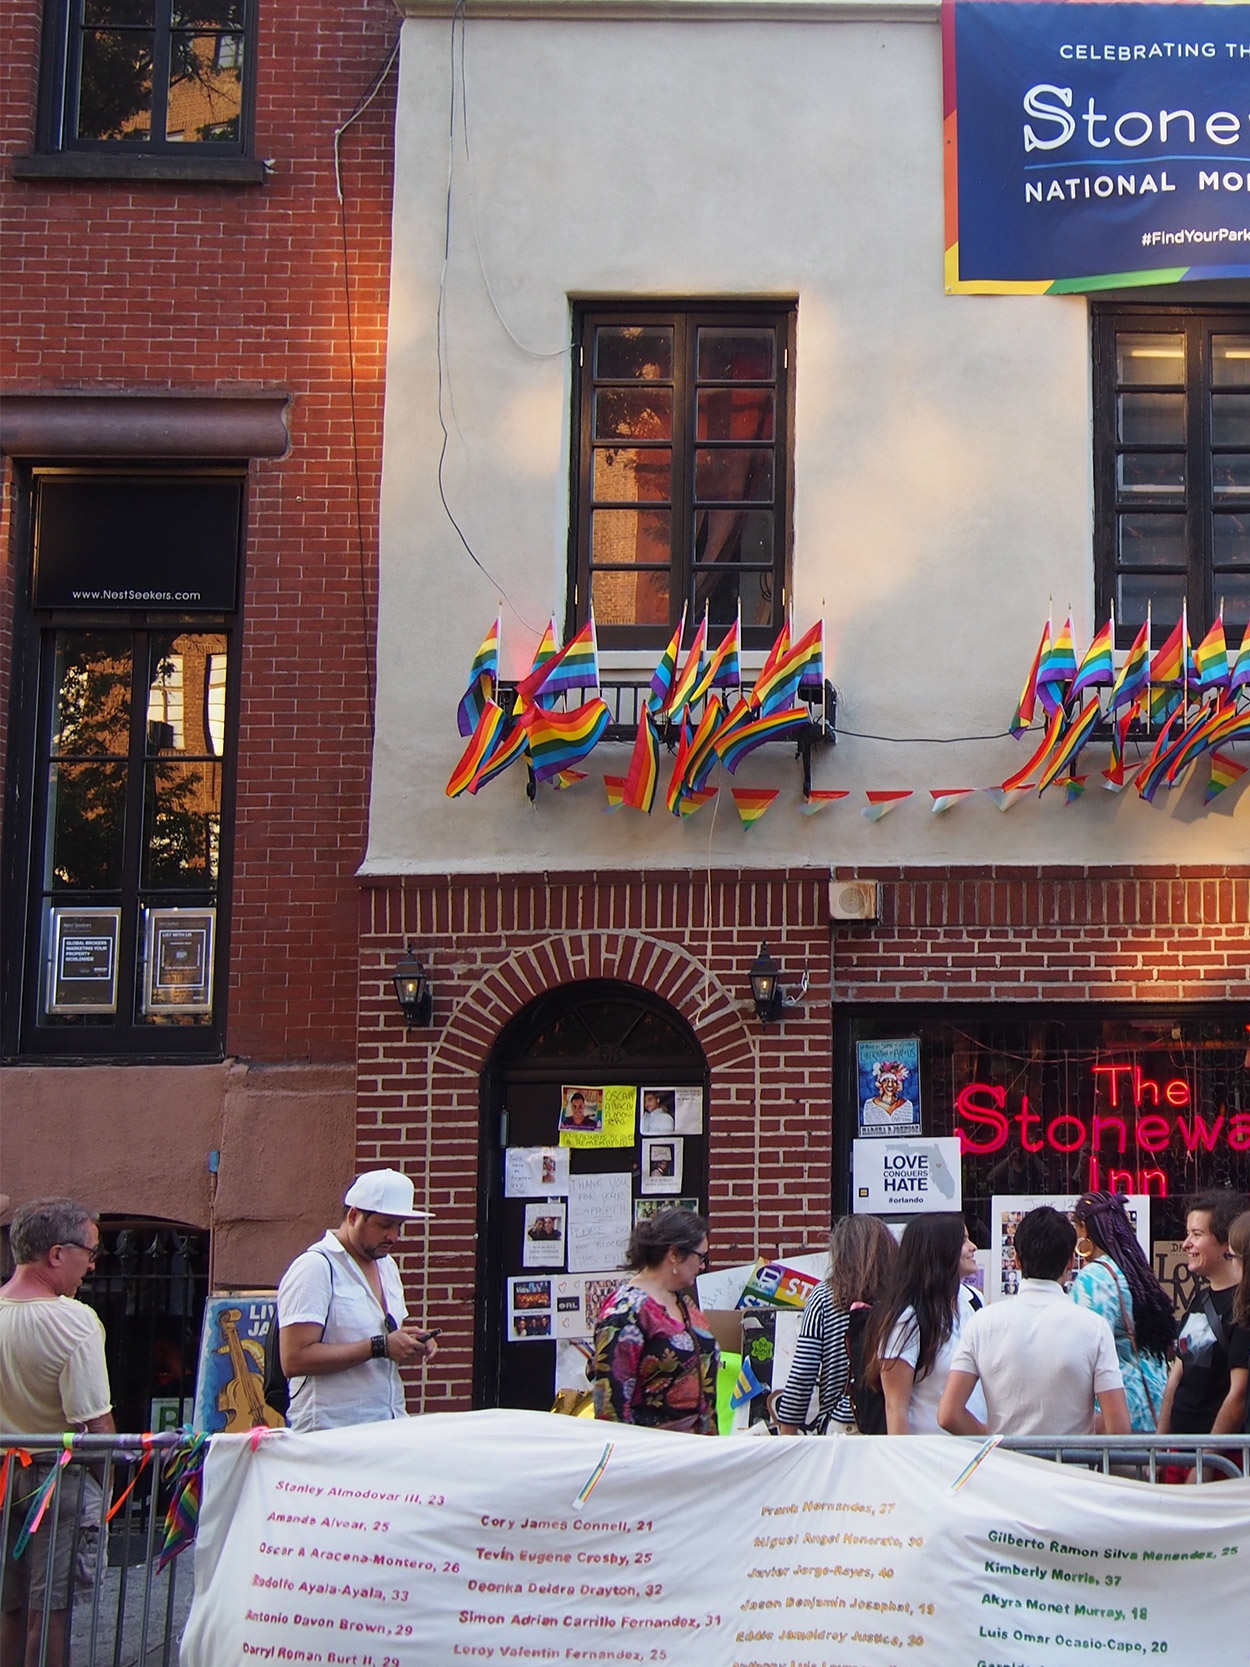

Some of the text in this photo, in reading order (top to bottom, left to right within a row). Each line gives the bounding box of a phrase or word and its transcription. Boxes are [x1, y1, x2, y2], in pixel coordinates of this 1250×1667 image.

[1060, 42, 1216, 62] CELEBRATING
[1026, 171, 1175, 203] NATIONAL
[72, 589, 201, 600] www.NestSeekers.com
[1091, 1065, 1190, 1107] The
[884, 1155, 928, 1169] LOVE
[883, 1170, 928, 1178] CONQUERS
[1088, 1155, 1168, 1198] Inn
[884, 1178, 928, 1192] HATE
[249, 1304, 277, 1320] LIV
[248, 1322, 270, 1336] JA
[276, 1481, 445, 1506] Stanley Almodovar III, 23
[761, 1504, 799, 1516] Frank
[879, 1503, 895, 1514] 27
[267, 1512, 390, 1532] Amanda Alvear, 25
[481, 1515, 653, 1533] Cory James Connell, 21
[754, 1534, 799, 1549] Miguel
[803, 1532, 840, 1545] Angel
[988, 1529, 1045, 1550] Gilberto
[1049, 1540, 1099, 1558] Ramon
[1103, 1548, 1138, 1560] Silva
[1221, 1546, 1238, 1557] 25
[259, 1542, 460, 1574] Oscar A Aracena-Montero, 26
[519, 1549, 571, 1565] Eugene
[577, 1552, 630, 1567] Crosby,
[634, 1552, 653, 1564] 25
[747, 1566, 790, 1580] Javier
[878, 1567, 894, 1578] 40
[984, 1560, 1122, 1587] Kimberly Morris, 37
[252, 1574, 409, 1602] Rodolfo Ayala-Ayala, 33
[468, 1579, 663, 1597] Deonka Deidra Drayton, 32
[785, 1596, 847, 1610] Benjamin
[981, 1593, 1148, 1621] Akyra Monet Murray, 18
[245, 1609, 413, 1636] Antonio Davon Brown, 29
[458, 1610, 721, 1629] Simon Adrian Carrillo Fernandez, 31
[735, 1630, 774, 1642] Eddie
[851, 1631, 903, 1648] Justice,
[907, 1634, 924, 1647] 30
[979, 1626, 1168, 1655] Luis Omar Ocasio-Capo, 20
[242, 1642, 400, 1667] Darryl Roman Burt II, 29
[453, 1644, 667, 1662] Leroy Valentin Fernandez, 25
